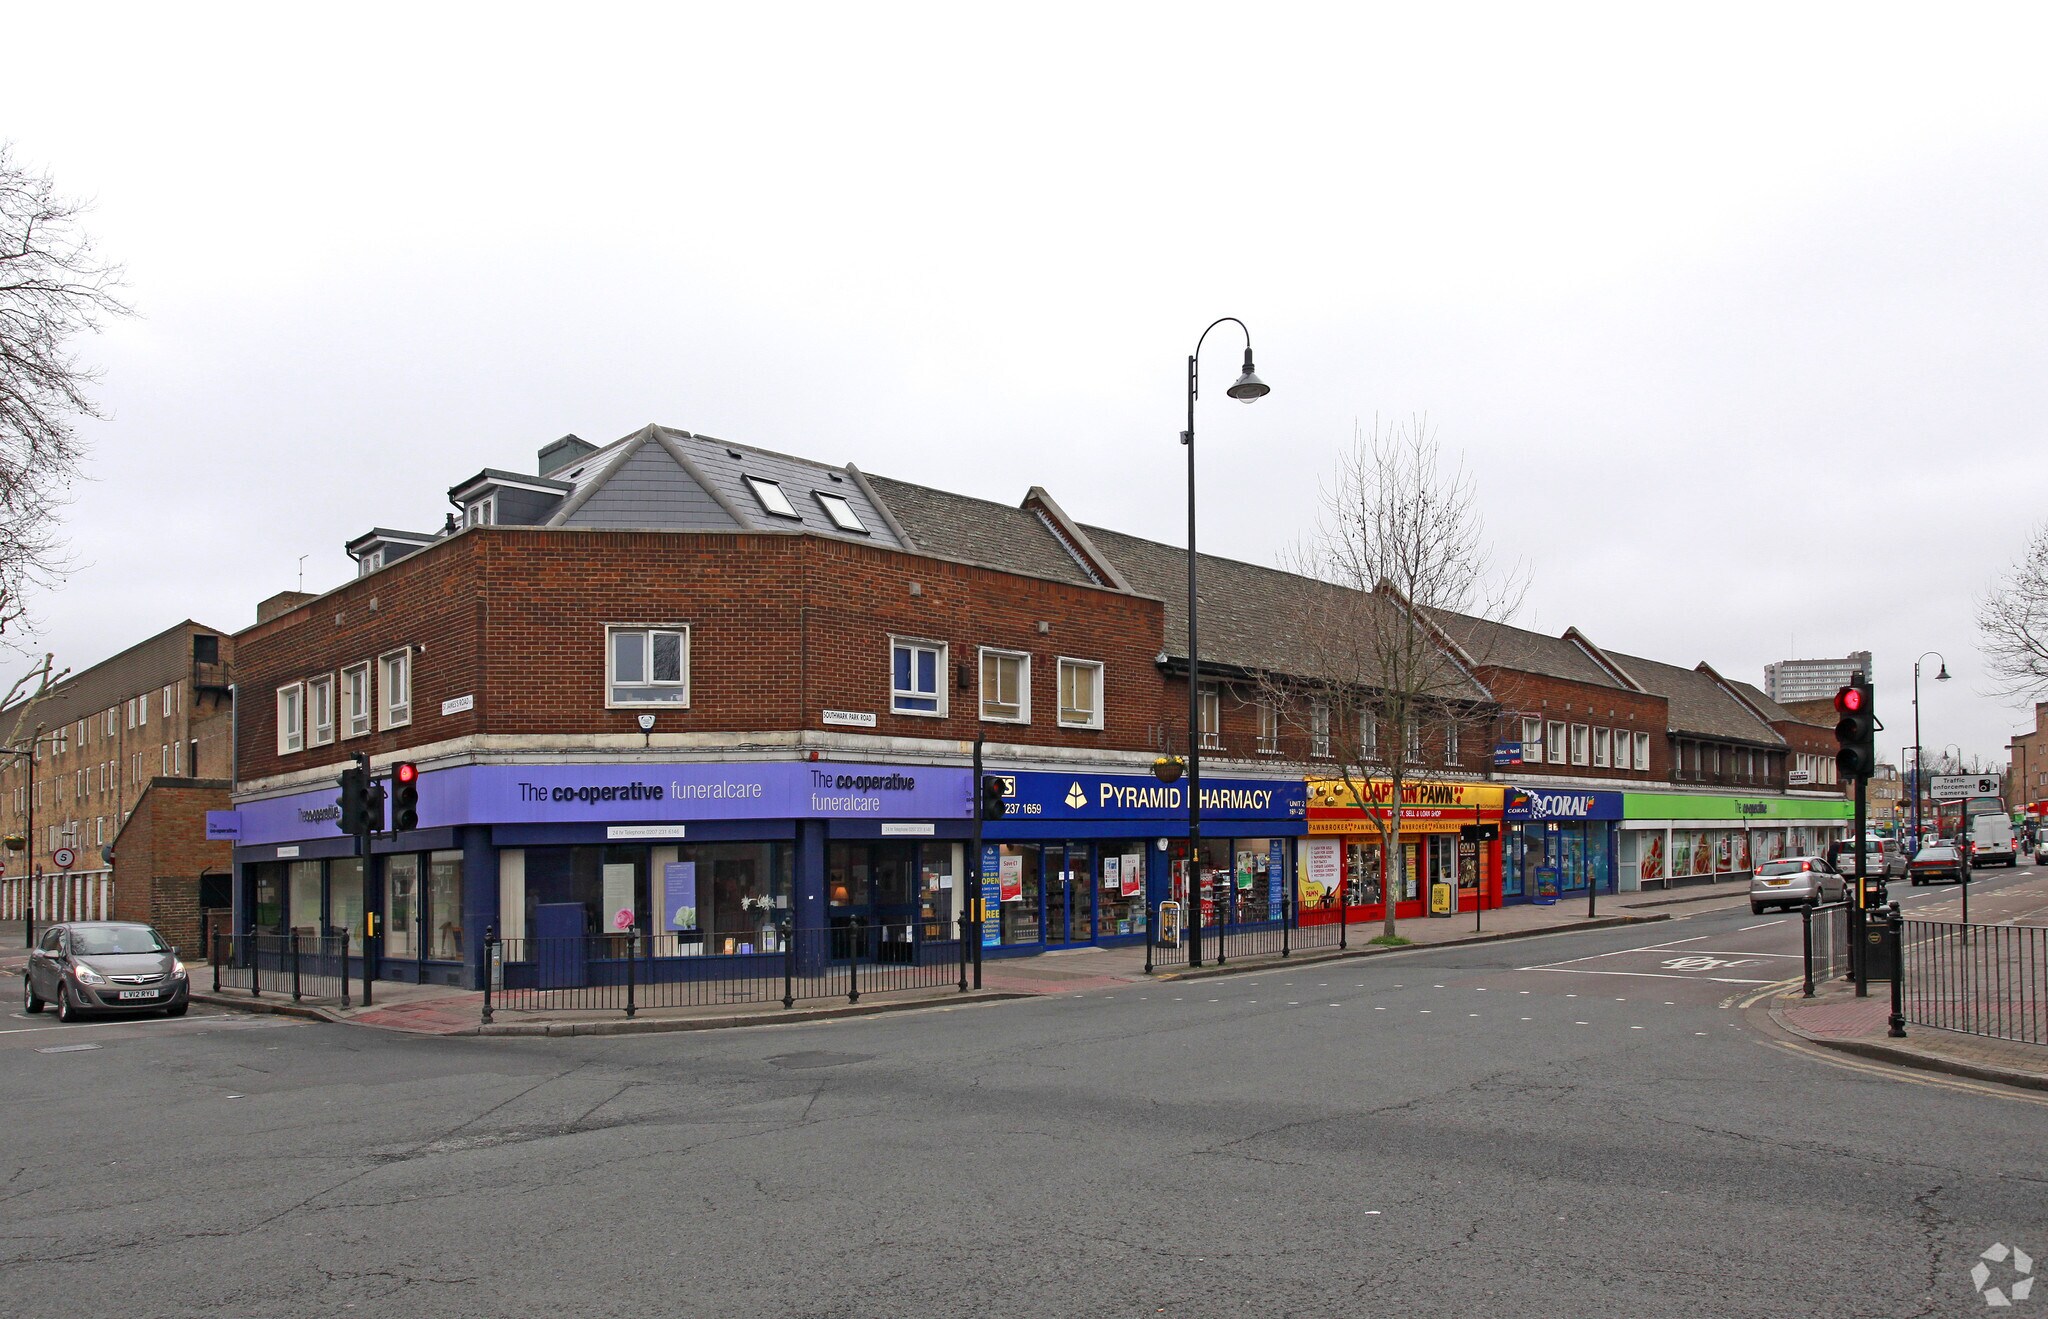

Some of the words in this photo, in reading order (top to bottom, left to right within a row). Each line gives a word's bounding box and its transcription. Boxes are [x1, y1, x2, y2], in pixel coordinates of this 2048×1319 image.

[823, 711, 848, 720] SOUTHWARK
[811, 770, 833, 788] The
[836, 773, 915, 793] co-operative
[518, 782, 548, 801] The
[551, 781, 664, 805] co-operative
[671, 780, 762, 799] funeralcare
[1100, 783, 1180, 808] PYRAMID
[1187, 785, 1272, 809] HARMACY
[1421, 785, 1453, 804] PAWN
[811, 792, 880, 811] funeralcare
[1005, 803, 1020, 814] 237
[1022, 803, 1041, 814] 1659
[1542, 795, 1587, 816] CORAL
[1309, 823, 1348, 831] PAWNBROKER
[1460, 843, 1475, 852] GOLD
[982, 877, 1000, 885] OPEN
[986, 910, 1000, 918] REE
